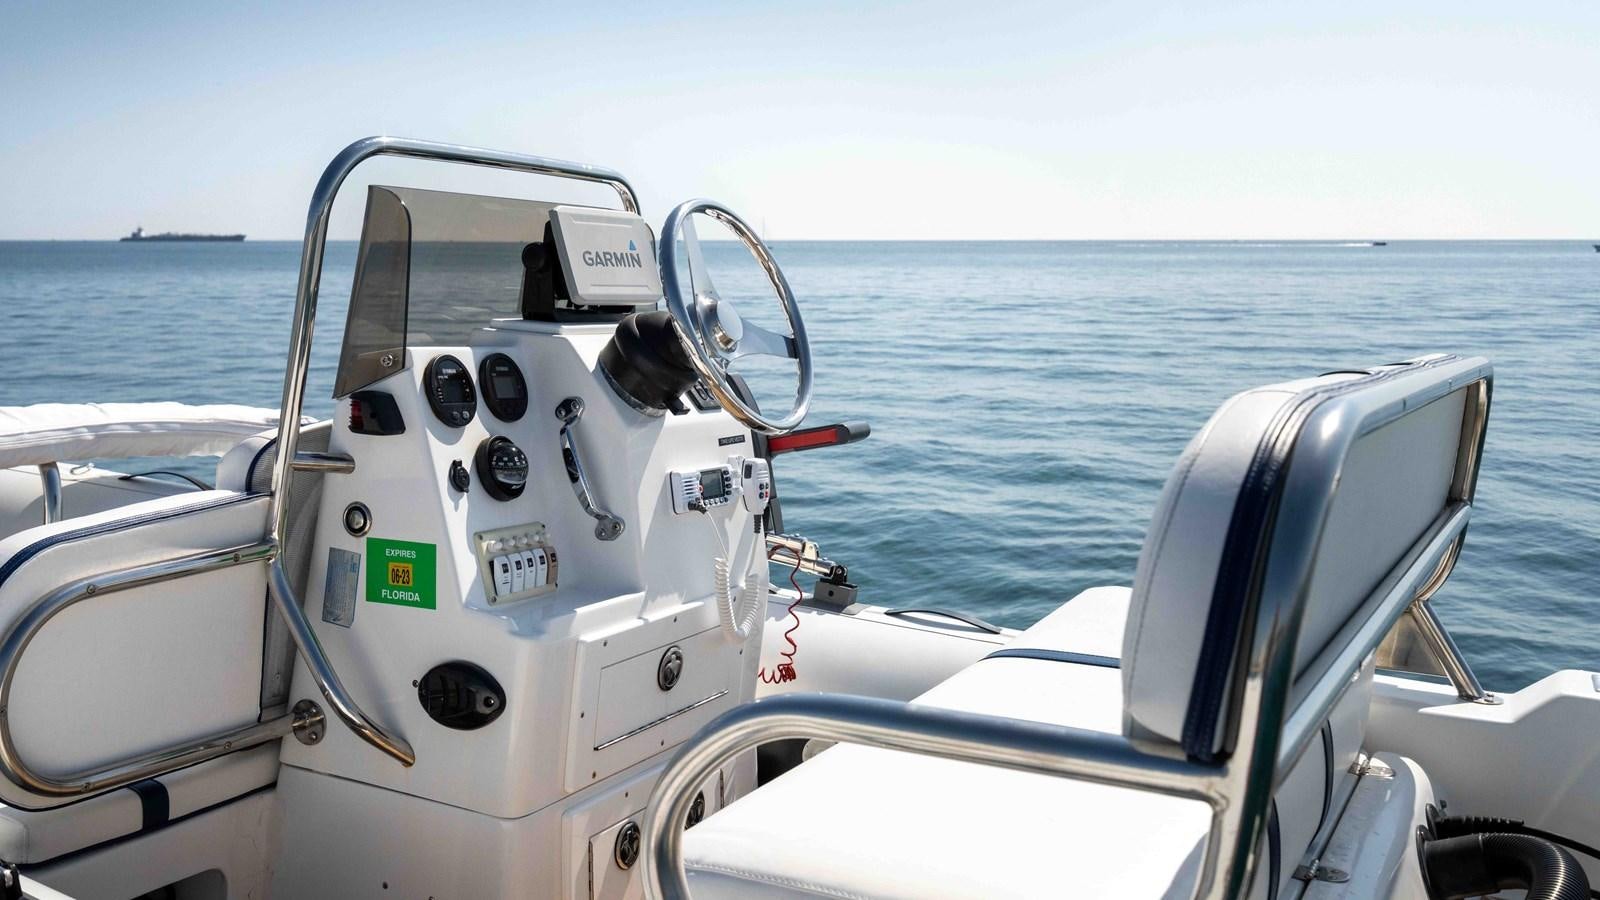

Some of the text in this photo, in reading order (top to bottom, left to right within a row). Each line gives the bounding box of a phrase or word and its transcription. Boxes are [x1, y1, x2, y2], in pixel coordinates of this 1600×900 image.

[582, 250, 642, 268] GARMIN
[385, 548, 416, 558] EXPIRES
[391, 568, 410, 585] 06-23
[381, 589, 421, 602] FLORIDA
